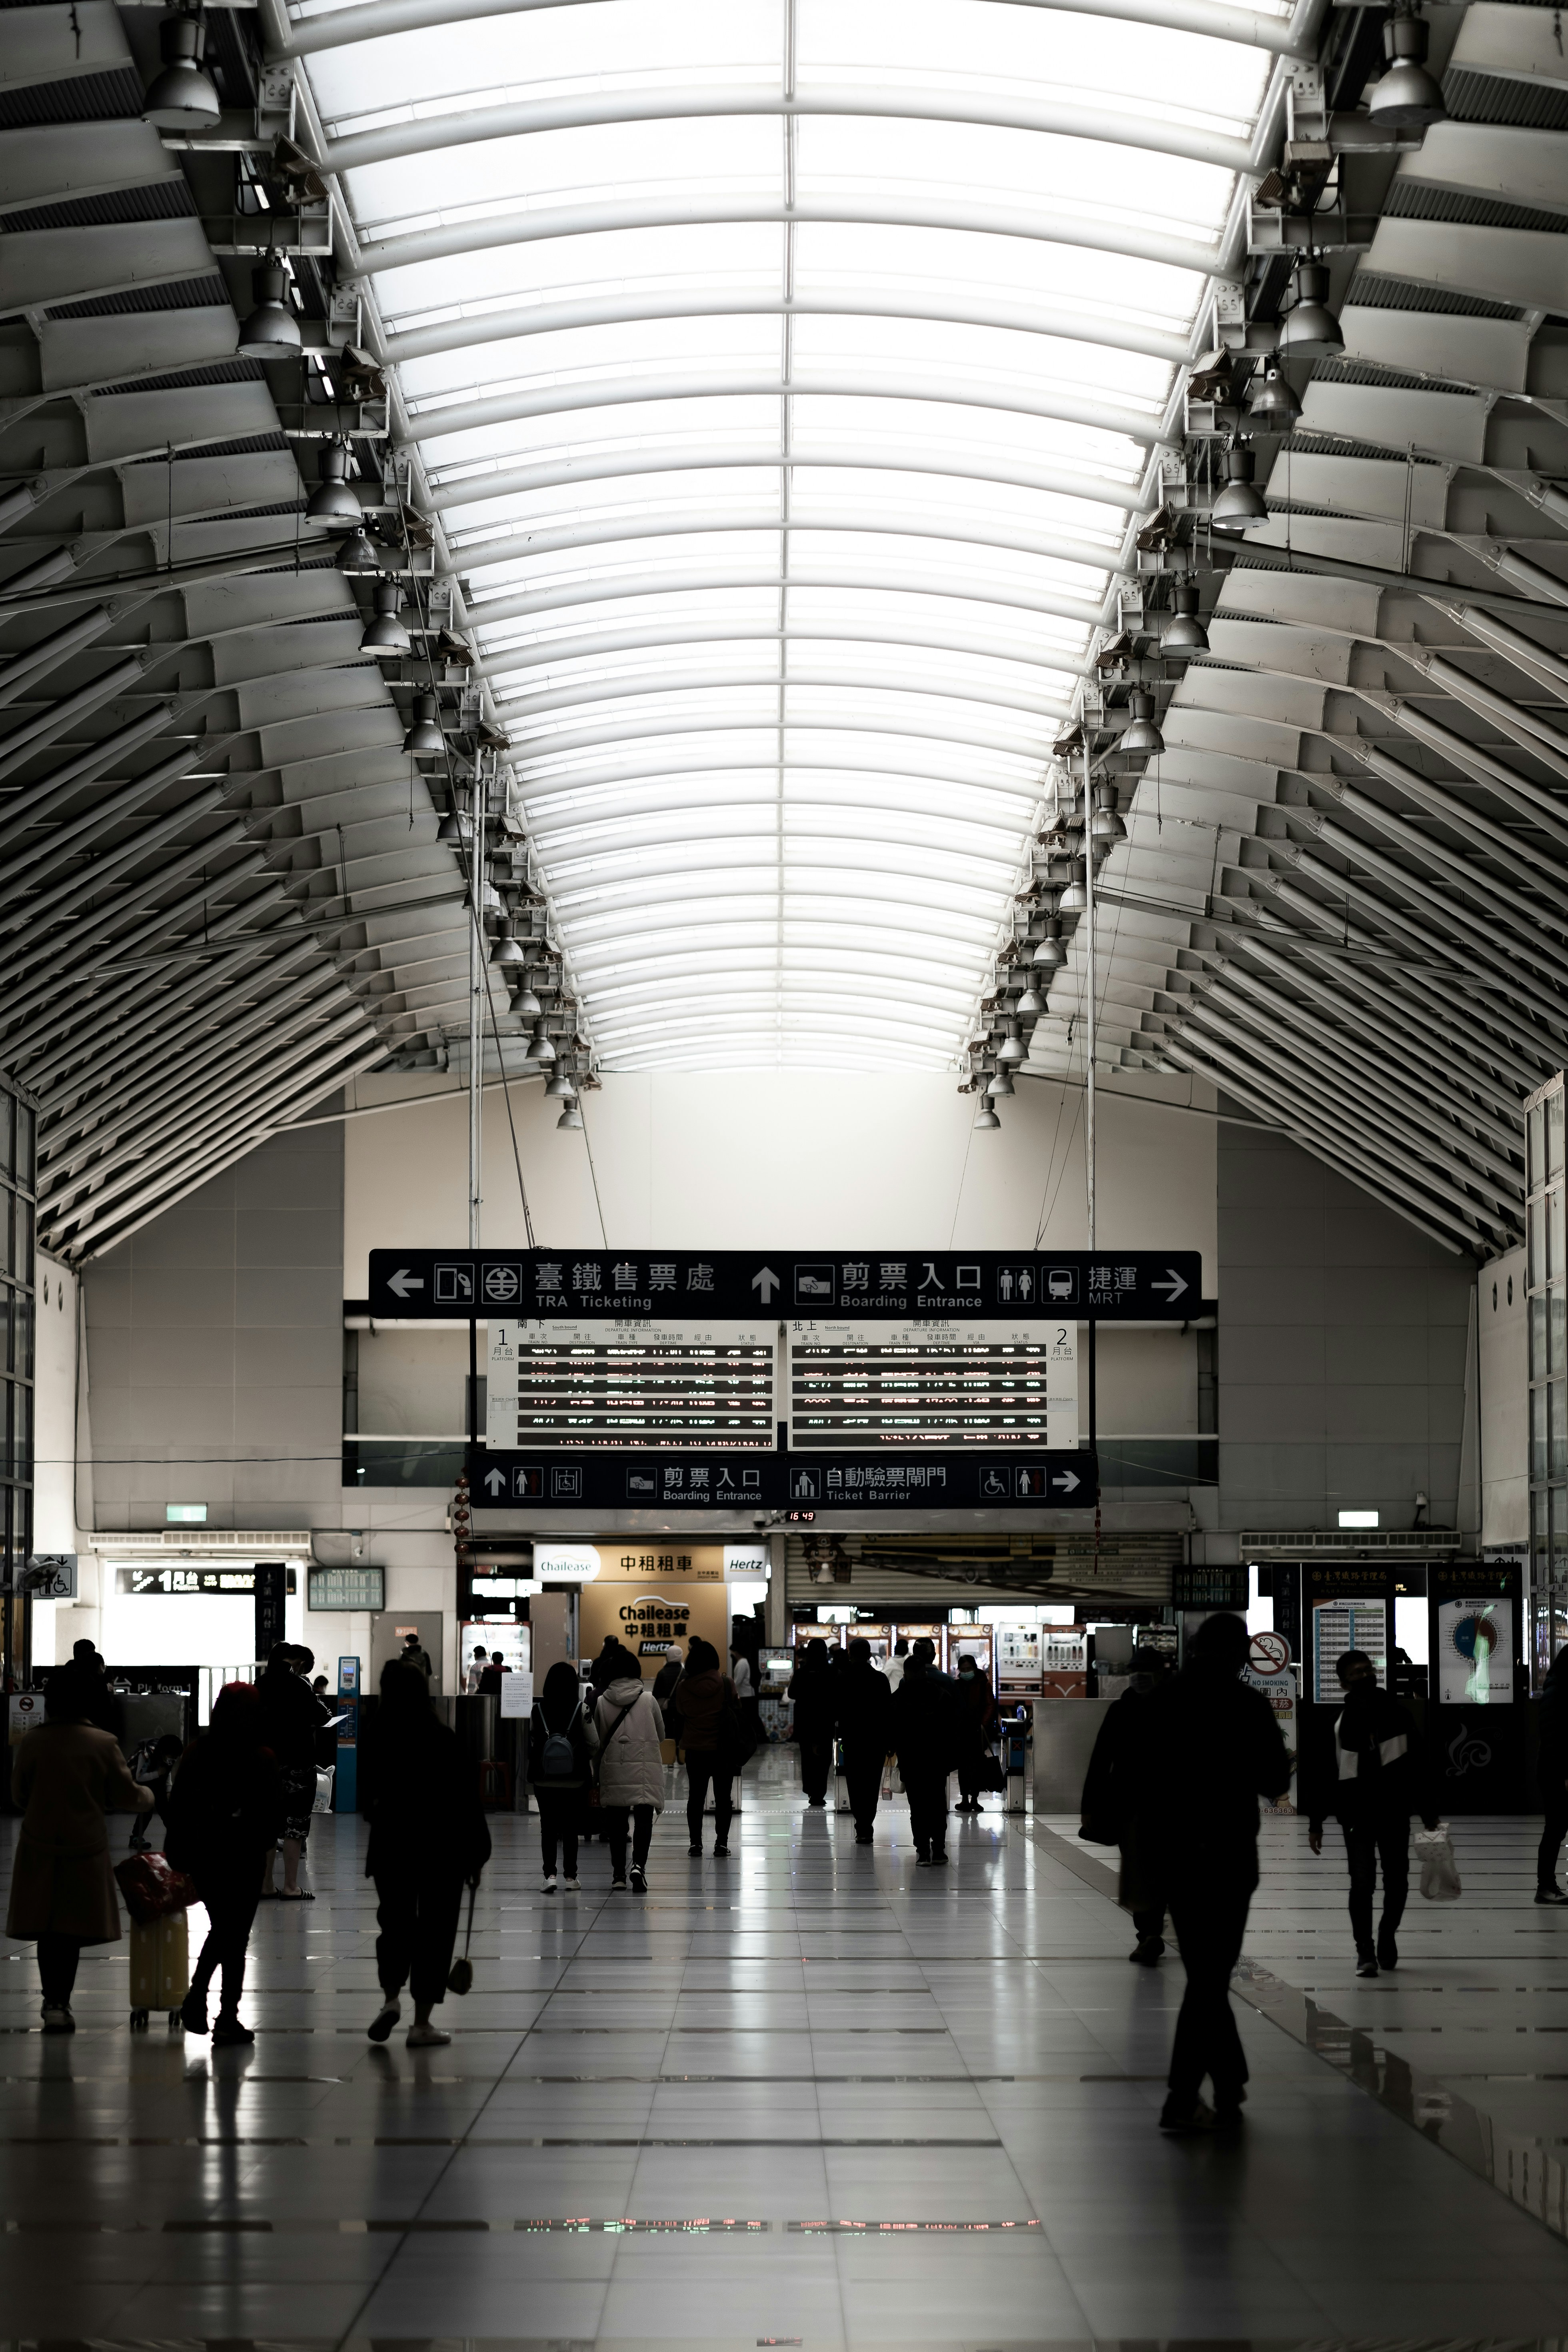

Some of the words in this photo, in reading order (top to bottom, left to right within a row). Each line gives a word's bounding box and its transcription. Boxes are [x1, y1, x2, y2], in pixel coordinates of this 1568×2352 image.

[535, 1262, 714, 1291] 臺鐵售票處
[841, 1262, 981, 1290] 剪票入口
[1089, 1266, 1137, 1290] 捷運
[536, 1295, 568, 1307] TRA
[580, 1296, 651, 1310] Ticketing
[841, 1295, 907, 1310] Boarding
[917, 1295, 982, 1307] Entrance
[1089, 1292, 1123, 1304] MRT
[517, 1319, 546, 1329] 南下
[792, 1320, 817, 1332] 北上
[498, 1329, 508, 1345] 1
[1057, 1328, 1067, 1345] 2
[493, 1347, 513, 1356] 月台
[1053, 1347, 1072, 1356] 月台
[664, 1467, 759, 1487] 剪票入口
[827, 1467, 946, 1487] 自動驗票閘門
[663, 1491, 709, 1502] Boarding
[717, 1491, 761, 1500] Entrance
[827, 1491, 863, 1500] Ticket
[869, 1490, 911, 1499] Barrier
[541, 1562, 591, 1571] Chailease
[620, 1555, 693, 1572] 中租租車
[730, 1559, 763, 1570] Hertz
[619, 1604, 690, 1621] Chailease
[625, 1622, 687, 1638] 中租租車
[642, 1643, 671, 1653] Hertz
